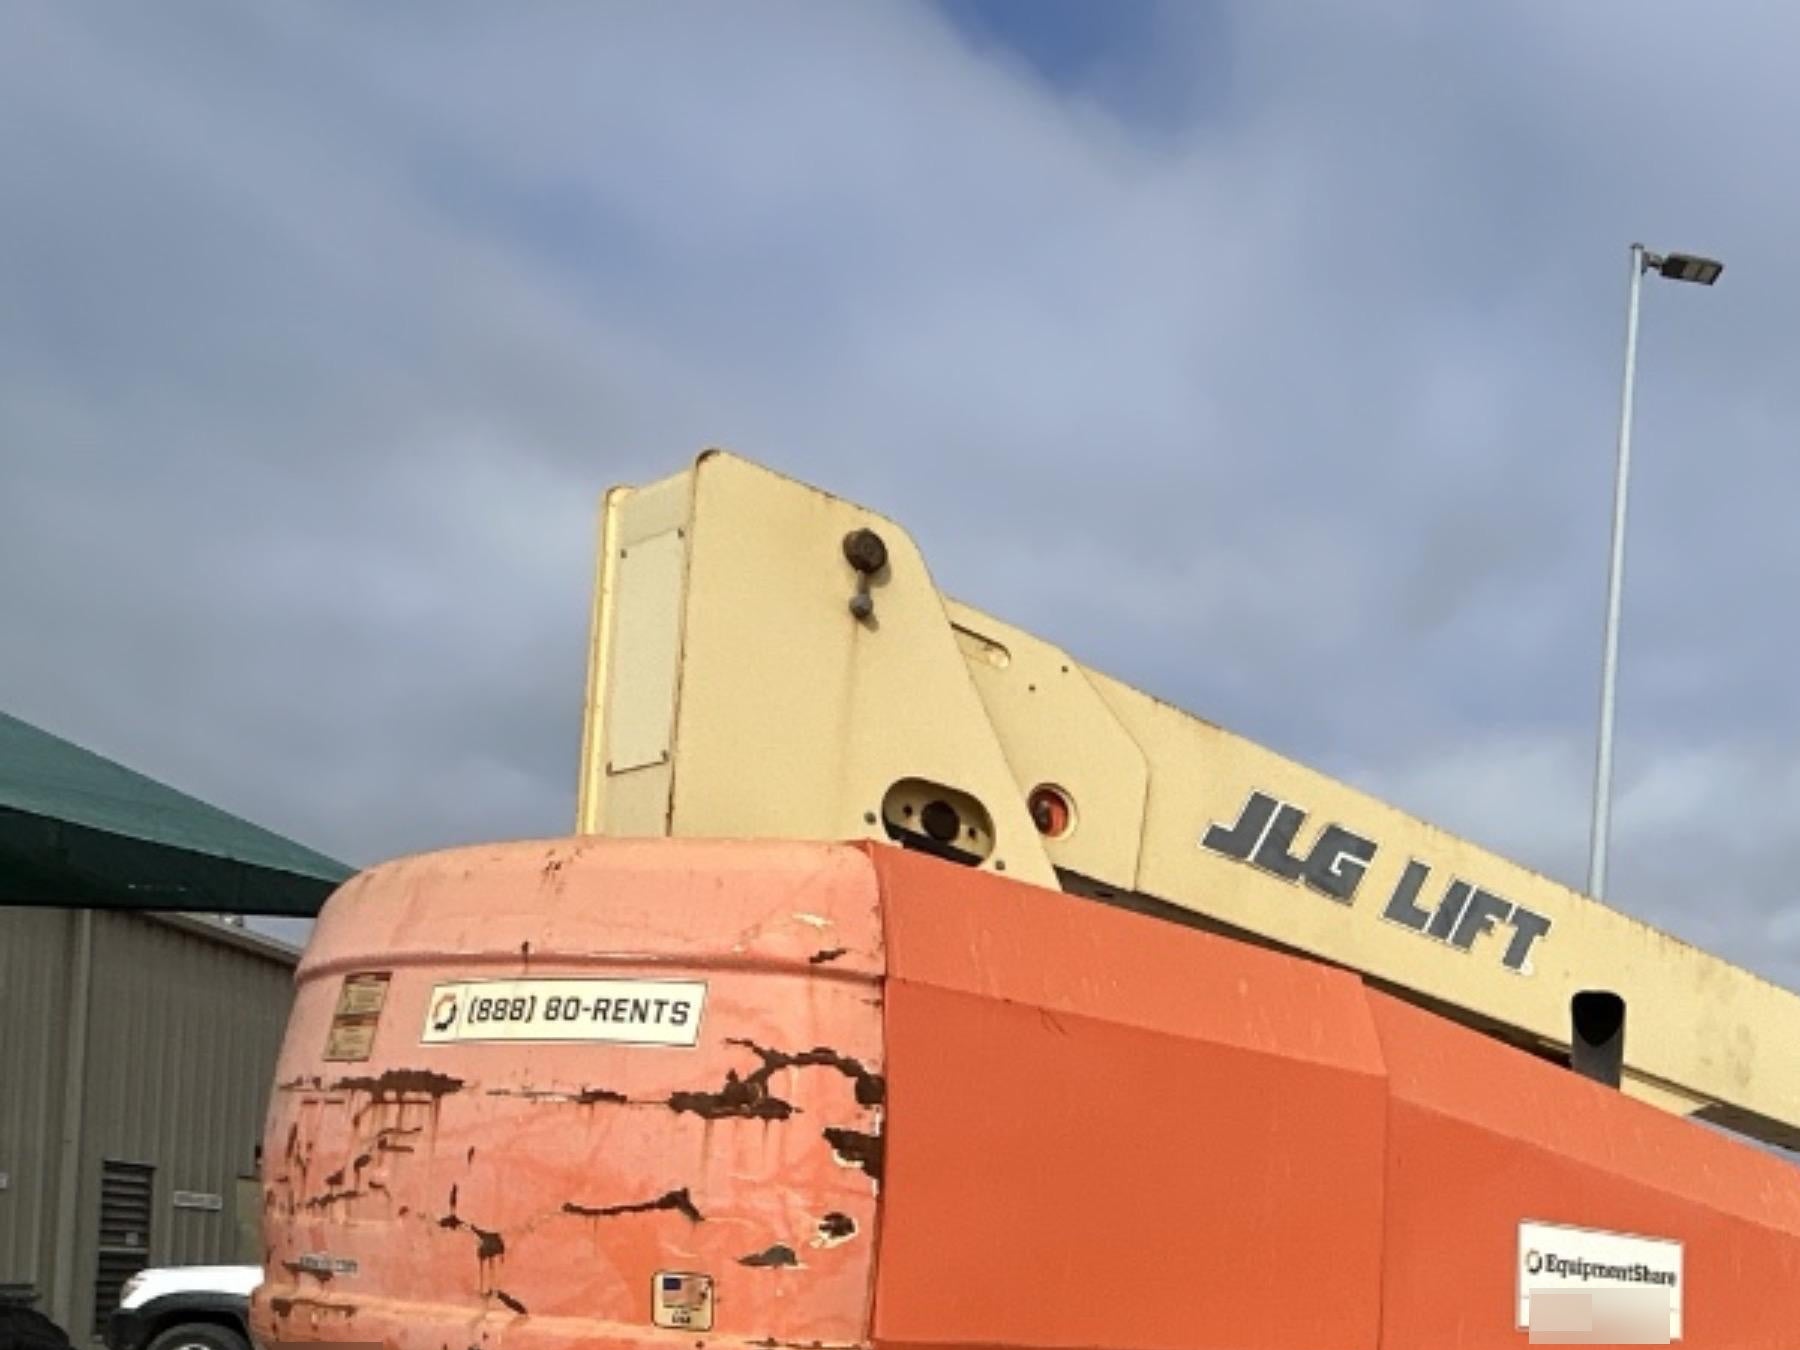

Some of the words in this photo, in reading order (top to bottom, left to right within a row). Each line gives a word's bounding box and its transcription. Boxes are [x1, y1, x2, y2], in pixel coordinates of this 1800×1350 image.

[1200, 788, 1378, 906] JLG
[1381, 856, 1554, 972] LIFT
[466, 995, 537, 1025] (888)
[543, 996, 692, 1027] 80-RENTS
[1544, 1252, 1677, 1287] EquipmentShare
